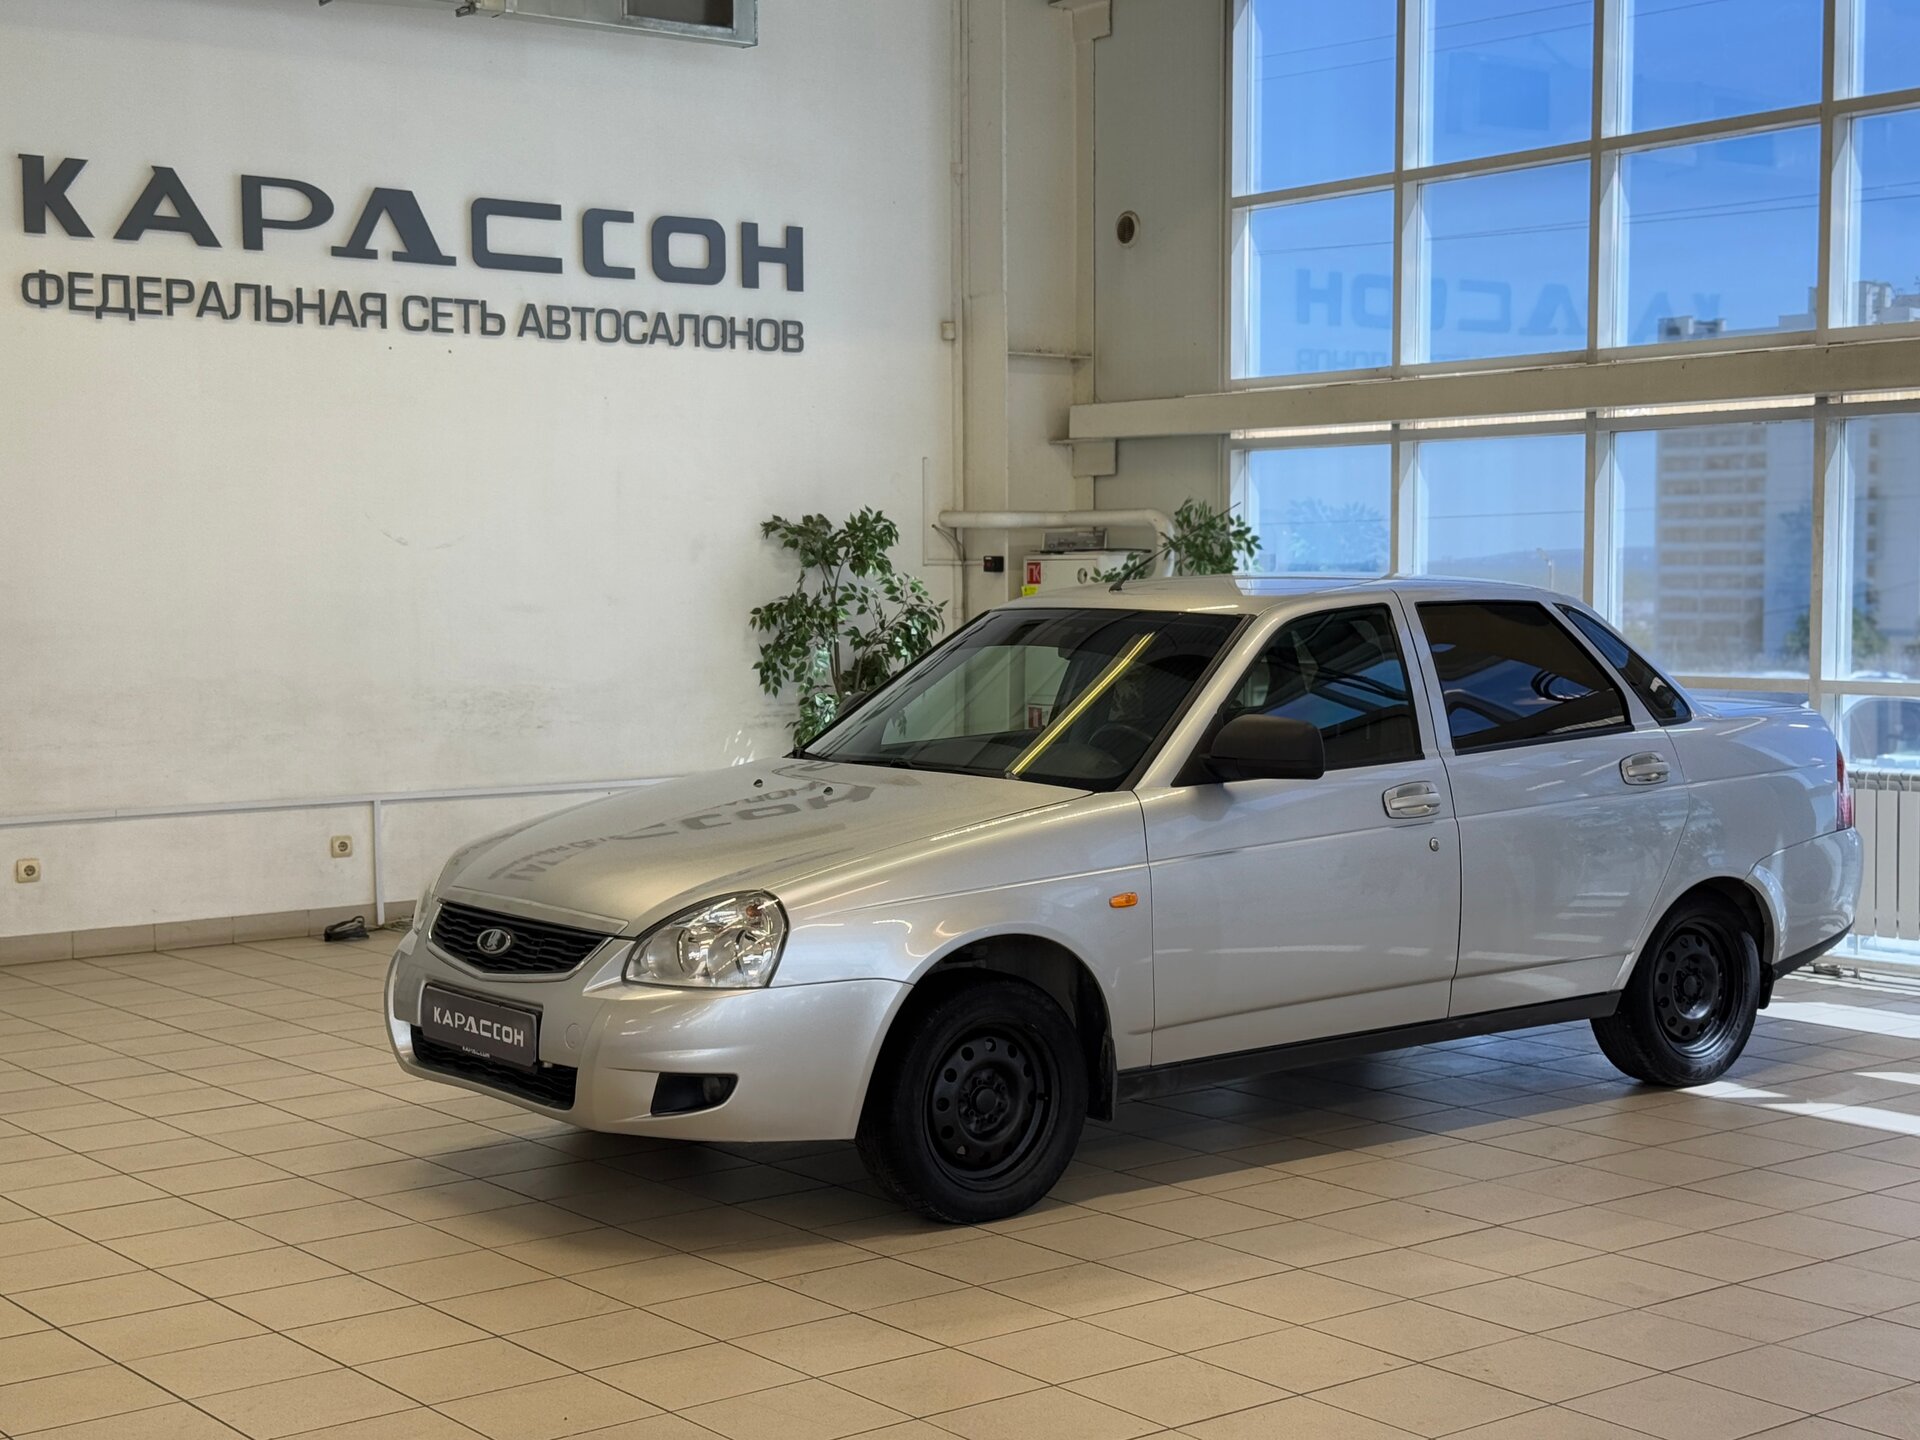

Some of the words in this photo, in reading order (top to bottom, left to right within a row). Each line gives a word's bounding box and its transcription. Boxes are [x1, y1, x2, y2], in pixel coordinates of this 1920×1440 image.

[20, 269, 389, 330] ФЕДЕРАЛЬНАЯ
[401, 294, 507, 337] СЕТЬ
[517, 302, 805, 353] АВТОСАЛОНОВ
[1027, 564, 1041, 582] ПК
